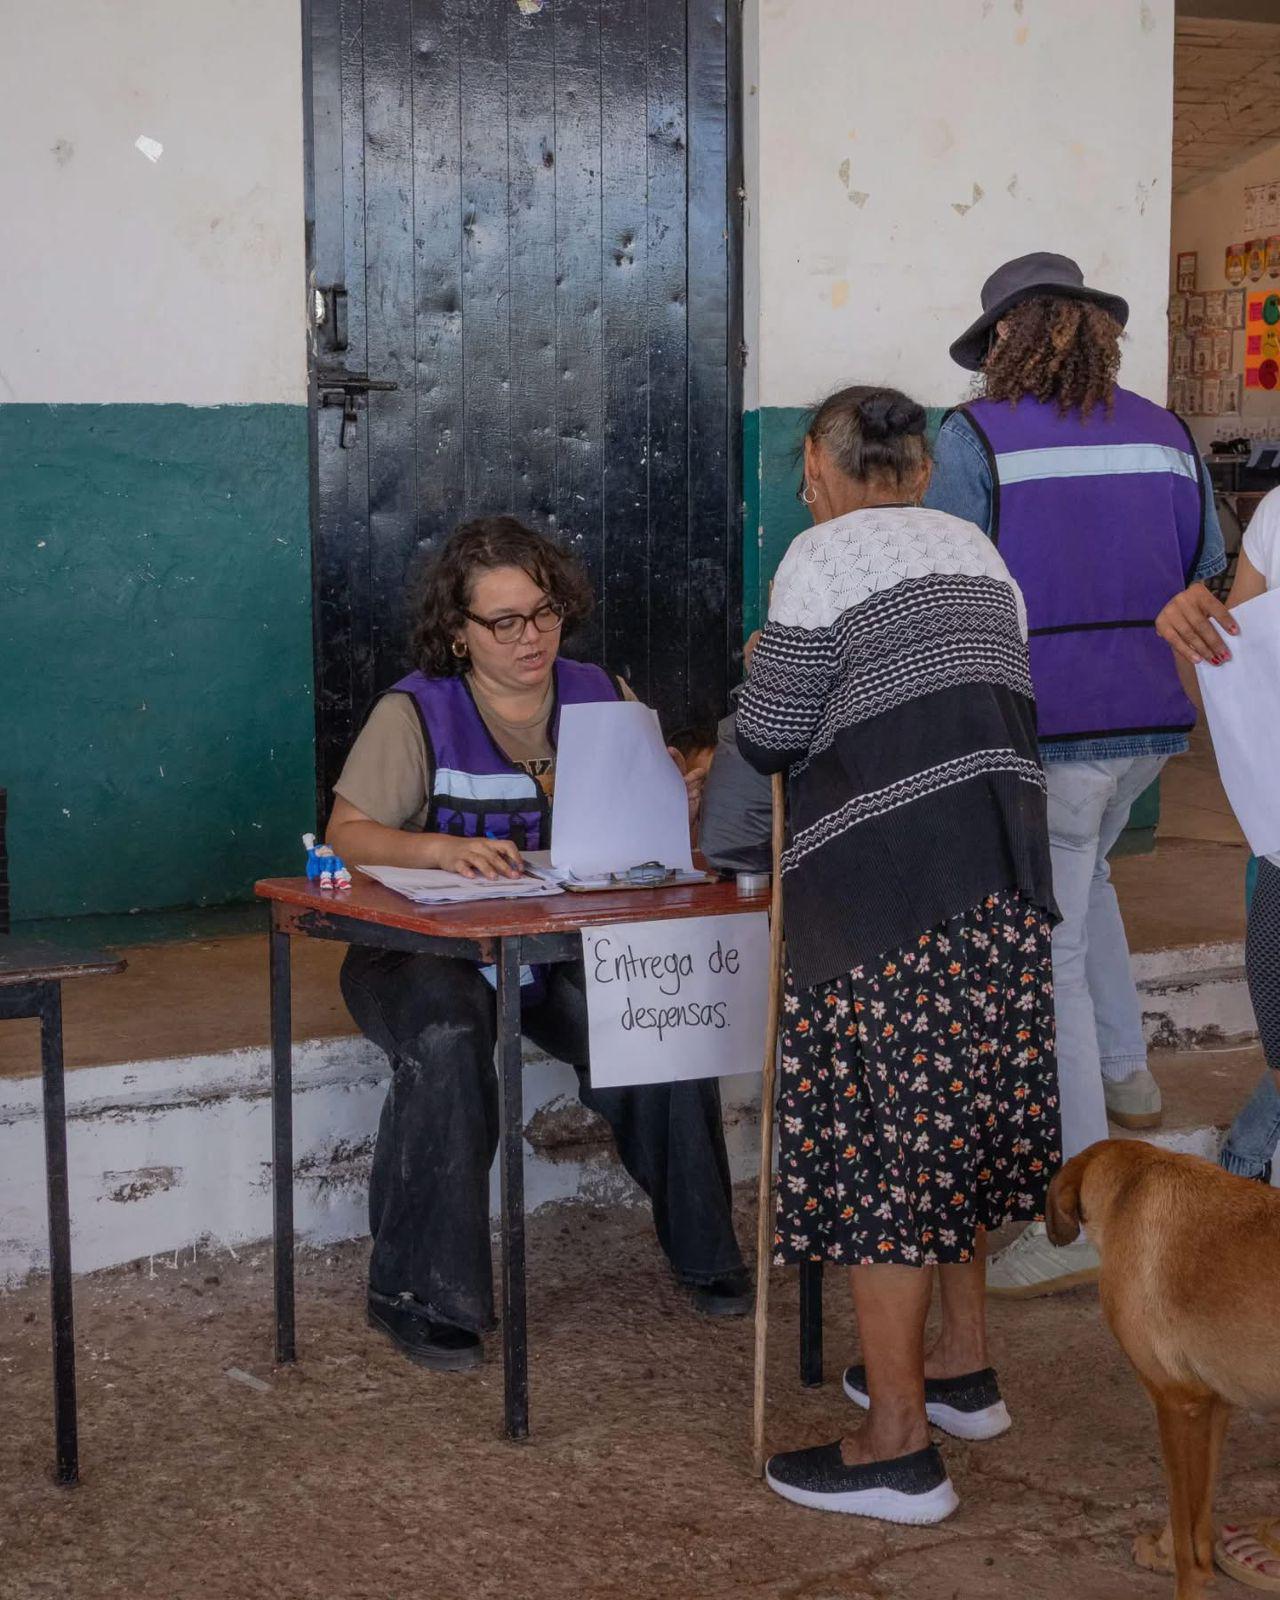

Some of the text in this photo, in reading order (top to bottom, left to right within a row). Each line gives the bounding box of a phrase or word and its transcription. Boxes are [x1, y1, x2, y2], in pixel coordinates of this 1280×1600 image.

[594, 938, 740, 995] Entrega de
[621, 997, 731, 1041] despensas.
